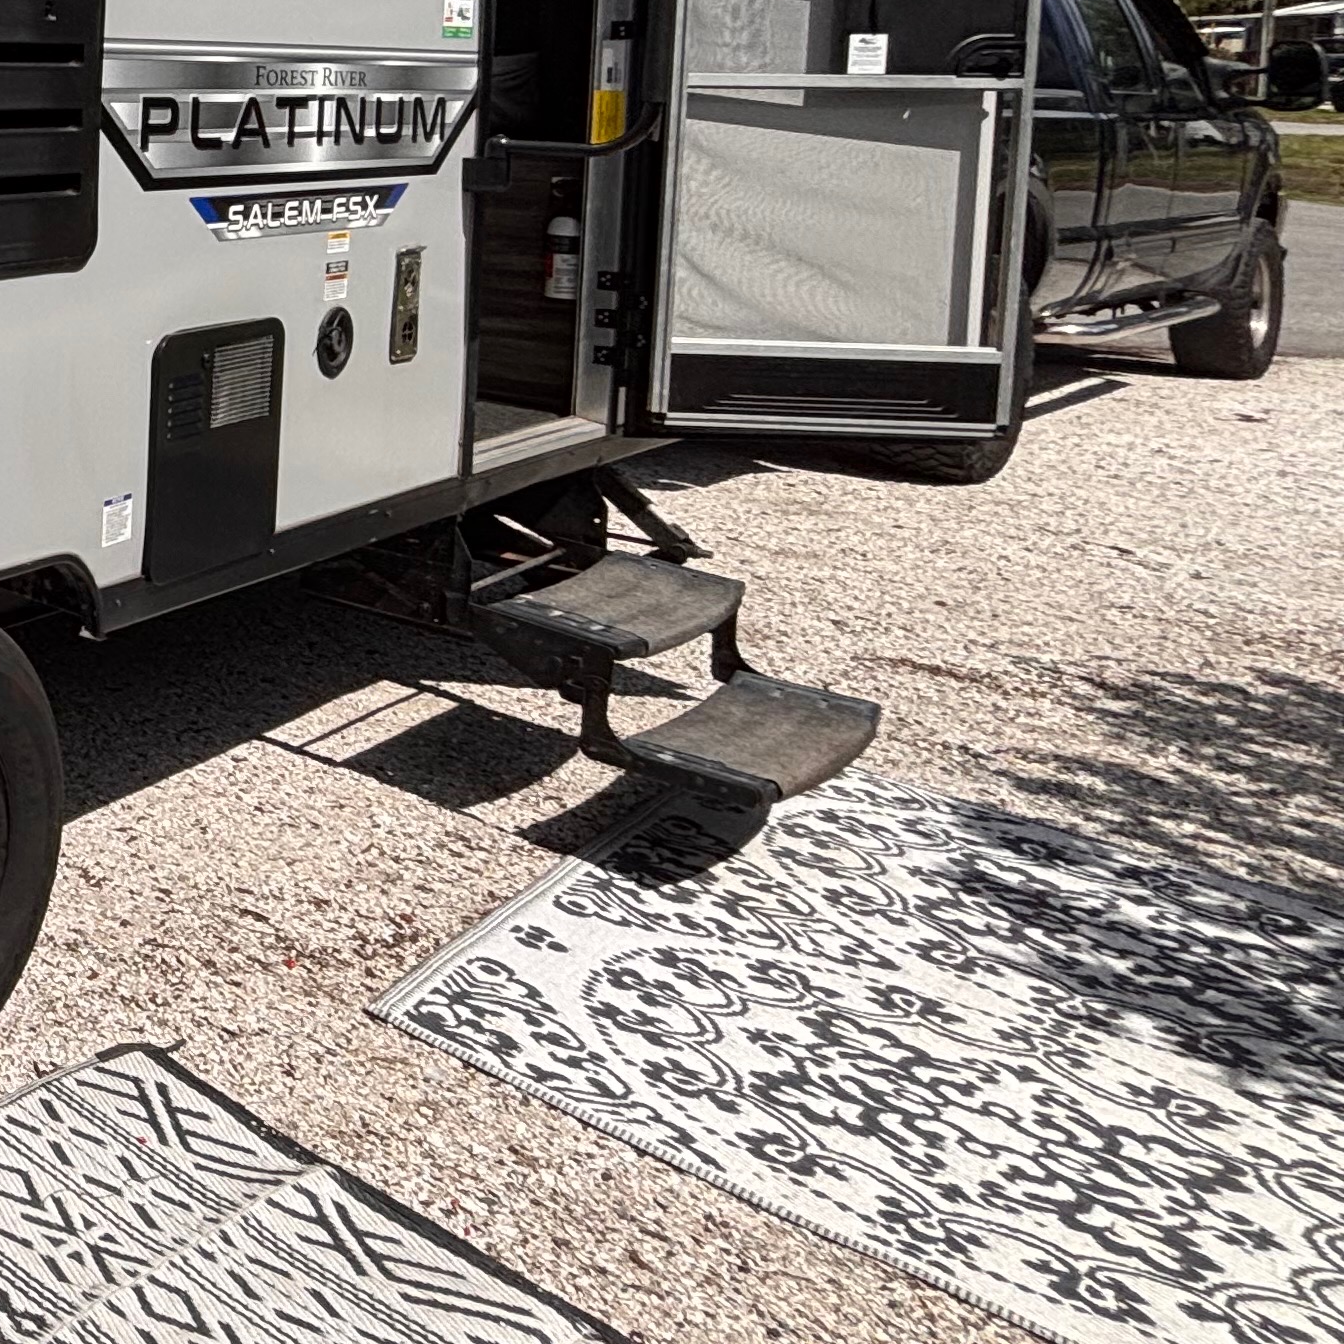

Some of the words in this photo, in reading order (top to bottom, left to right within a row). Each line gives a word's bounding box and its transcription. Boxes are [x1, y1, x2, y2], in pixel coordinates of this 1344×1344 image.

[140, 96, 446, 152] PLATINUM
[228, 199, 322, 231] SALEM
[332, 194, 380, 222] FSX
